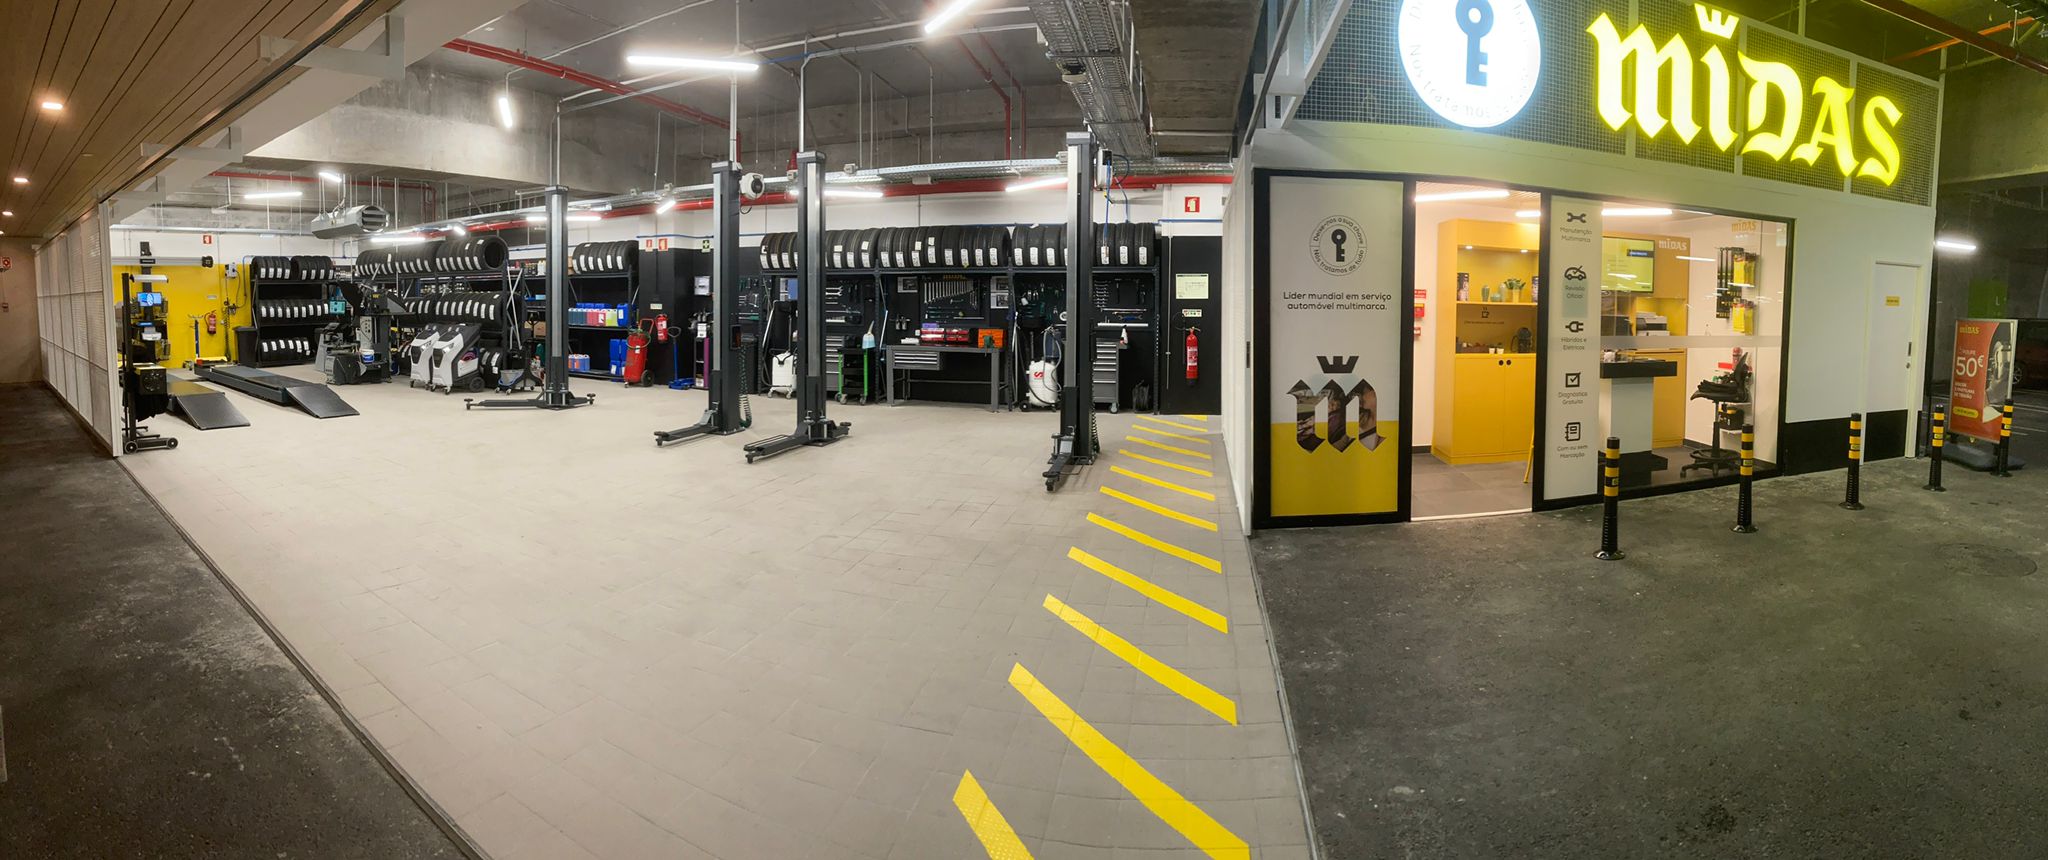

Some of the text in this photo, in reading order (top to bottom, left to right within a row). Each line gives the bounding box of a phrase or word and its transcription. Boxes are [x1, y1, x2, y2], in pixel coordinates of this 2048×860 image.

[1320, 261, 1348, 273] tratamos
[1308, 292, 1344, 300] mundial
[1361, 293, 1392, 302] serviço
[1287, 302, 1334, 310] automóvel
